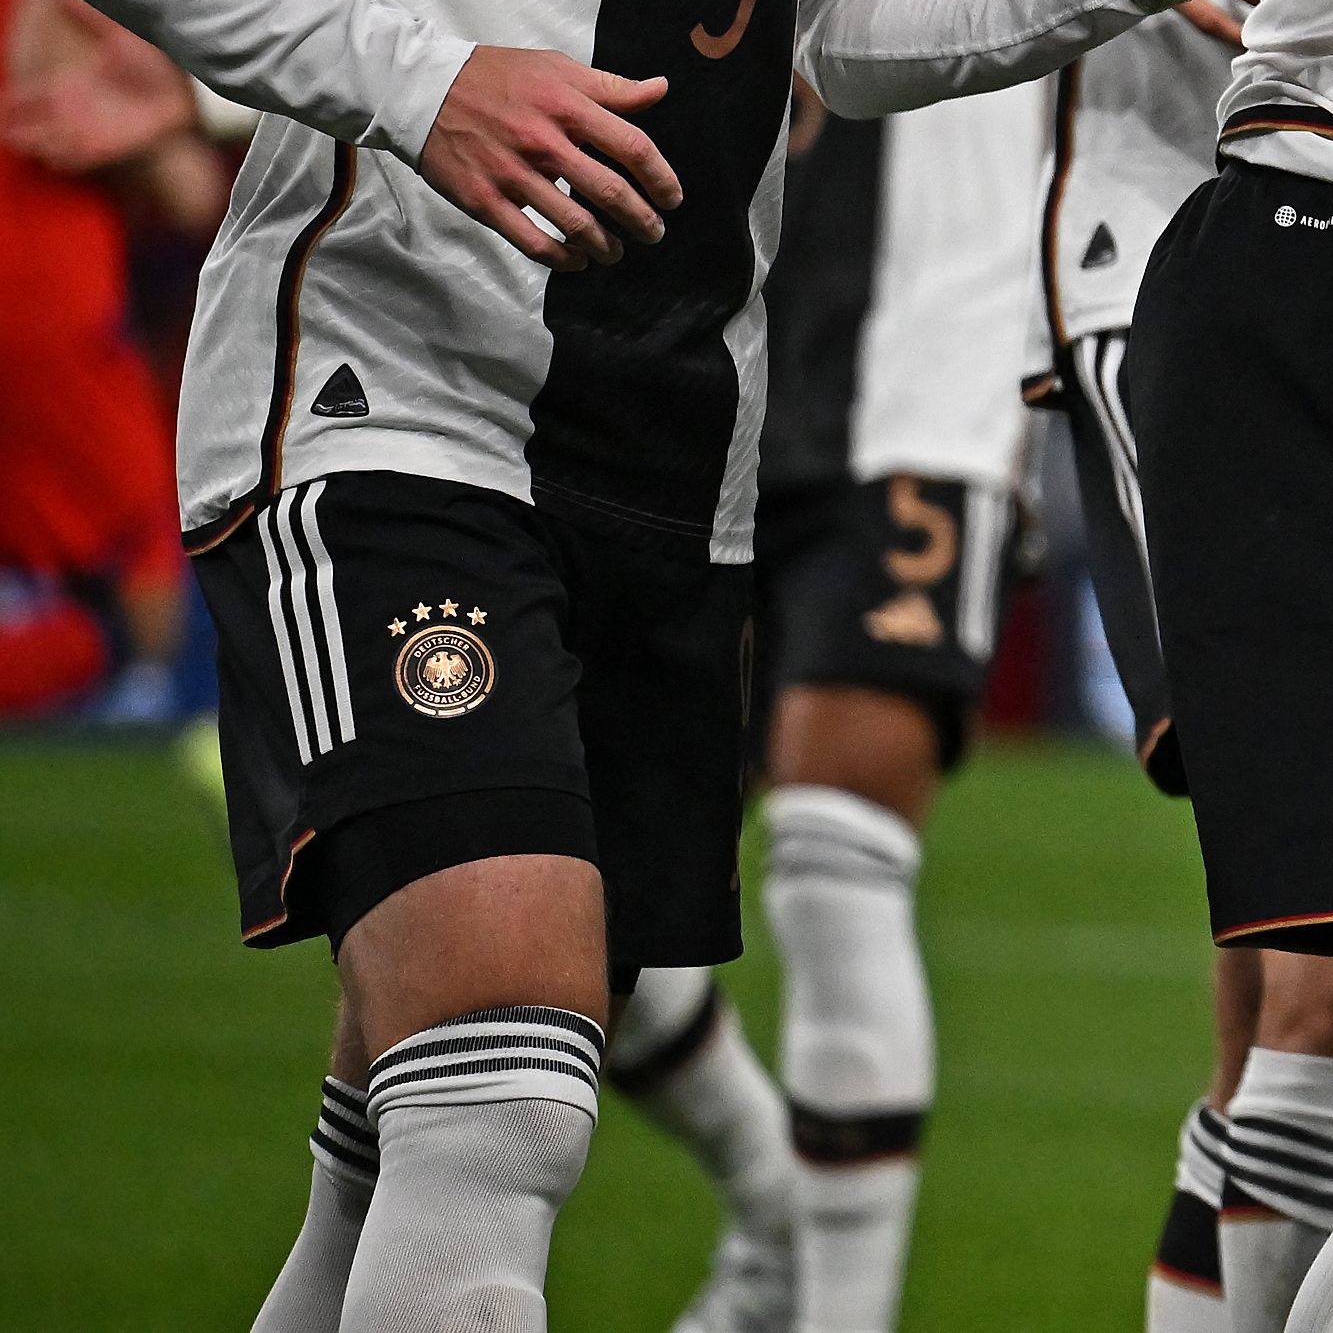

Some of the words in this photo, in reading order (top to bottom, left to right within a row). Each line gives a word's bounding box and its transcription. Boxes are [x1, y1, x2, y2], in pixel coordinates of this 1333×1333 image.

[884, 473, 957, 584] 5
[413, 637, 470, 658] DEUTSCHER
[412, 675, 481, 704] FUSSBALL-BUND
